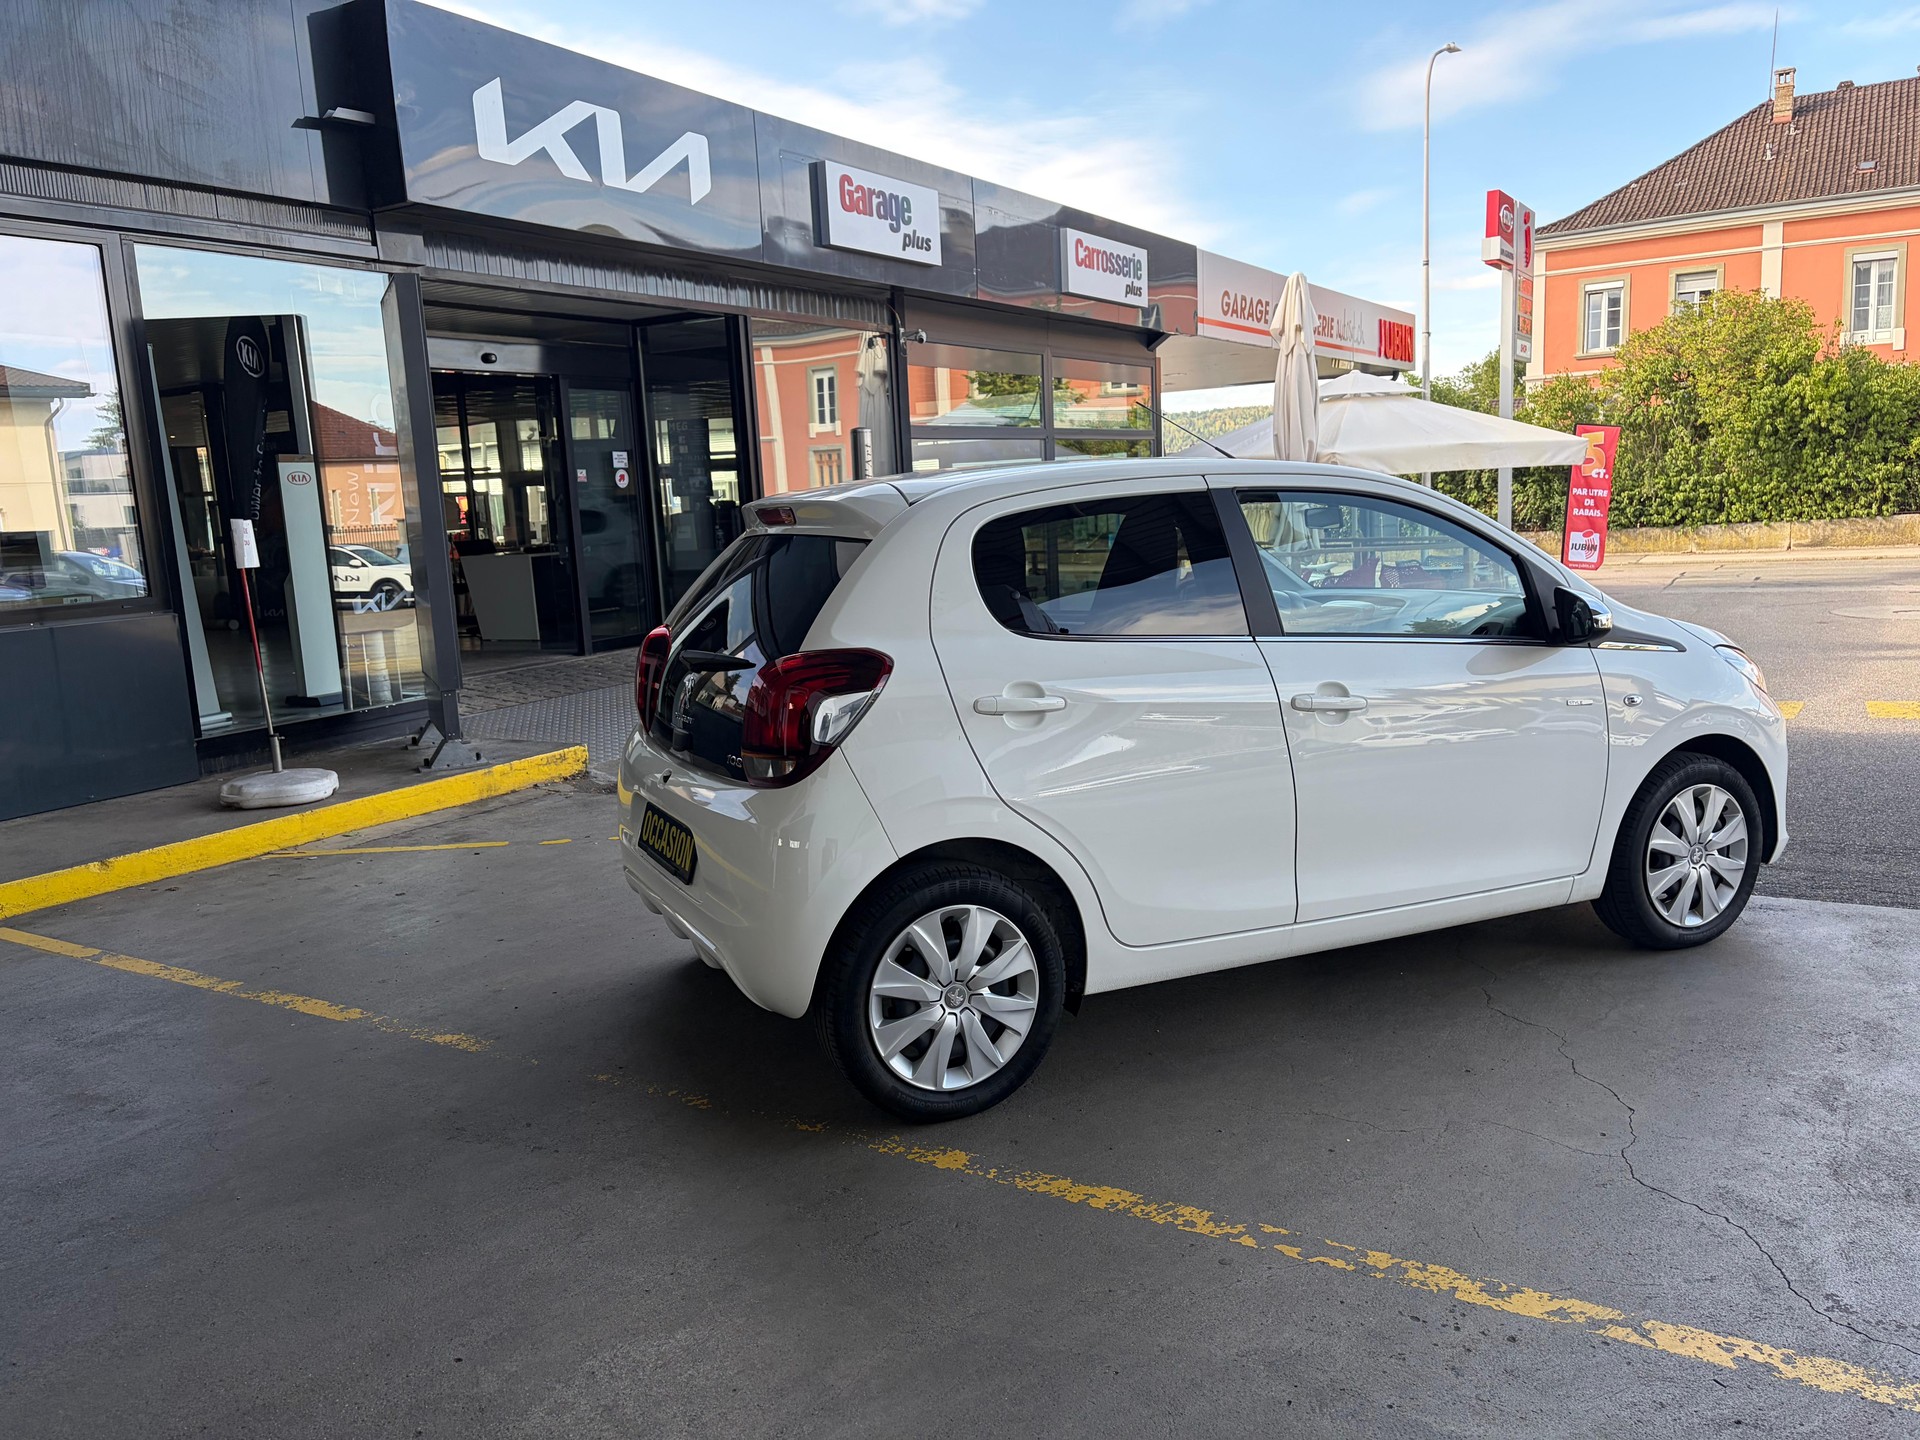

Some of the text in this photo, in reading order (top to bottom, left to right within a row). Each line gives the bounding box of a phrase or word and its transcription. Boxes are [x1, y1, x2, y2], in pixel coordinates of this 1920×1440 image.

[473, 77, 711, 205] KIA
[839, 174, 912, 233] Garage
[902, 229, 932, 251] plus
[1074, 238, 1142, 281] Carrosserie
[1125, 281, 1142, 298] plus
[1221, 289, 1270, 325] GARAGE
[238, 338, 262, 374] KIA
[1378, 318, 1414, 363] JUBIN
[1581, 431, 1609, 479] 5 CT.
[290, 474, 309, 483] KIA
[1572, 488, 1608, 497] PAR LITRE
[346, 471, 360, 526] New
[1573, 508, 1603, 517] RABAIS.
[1571, 542, 1597, 551] JUBIN
[726, 754, 743, 768] 108
[642, 811, 694, 872] OCCASION
